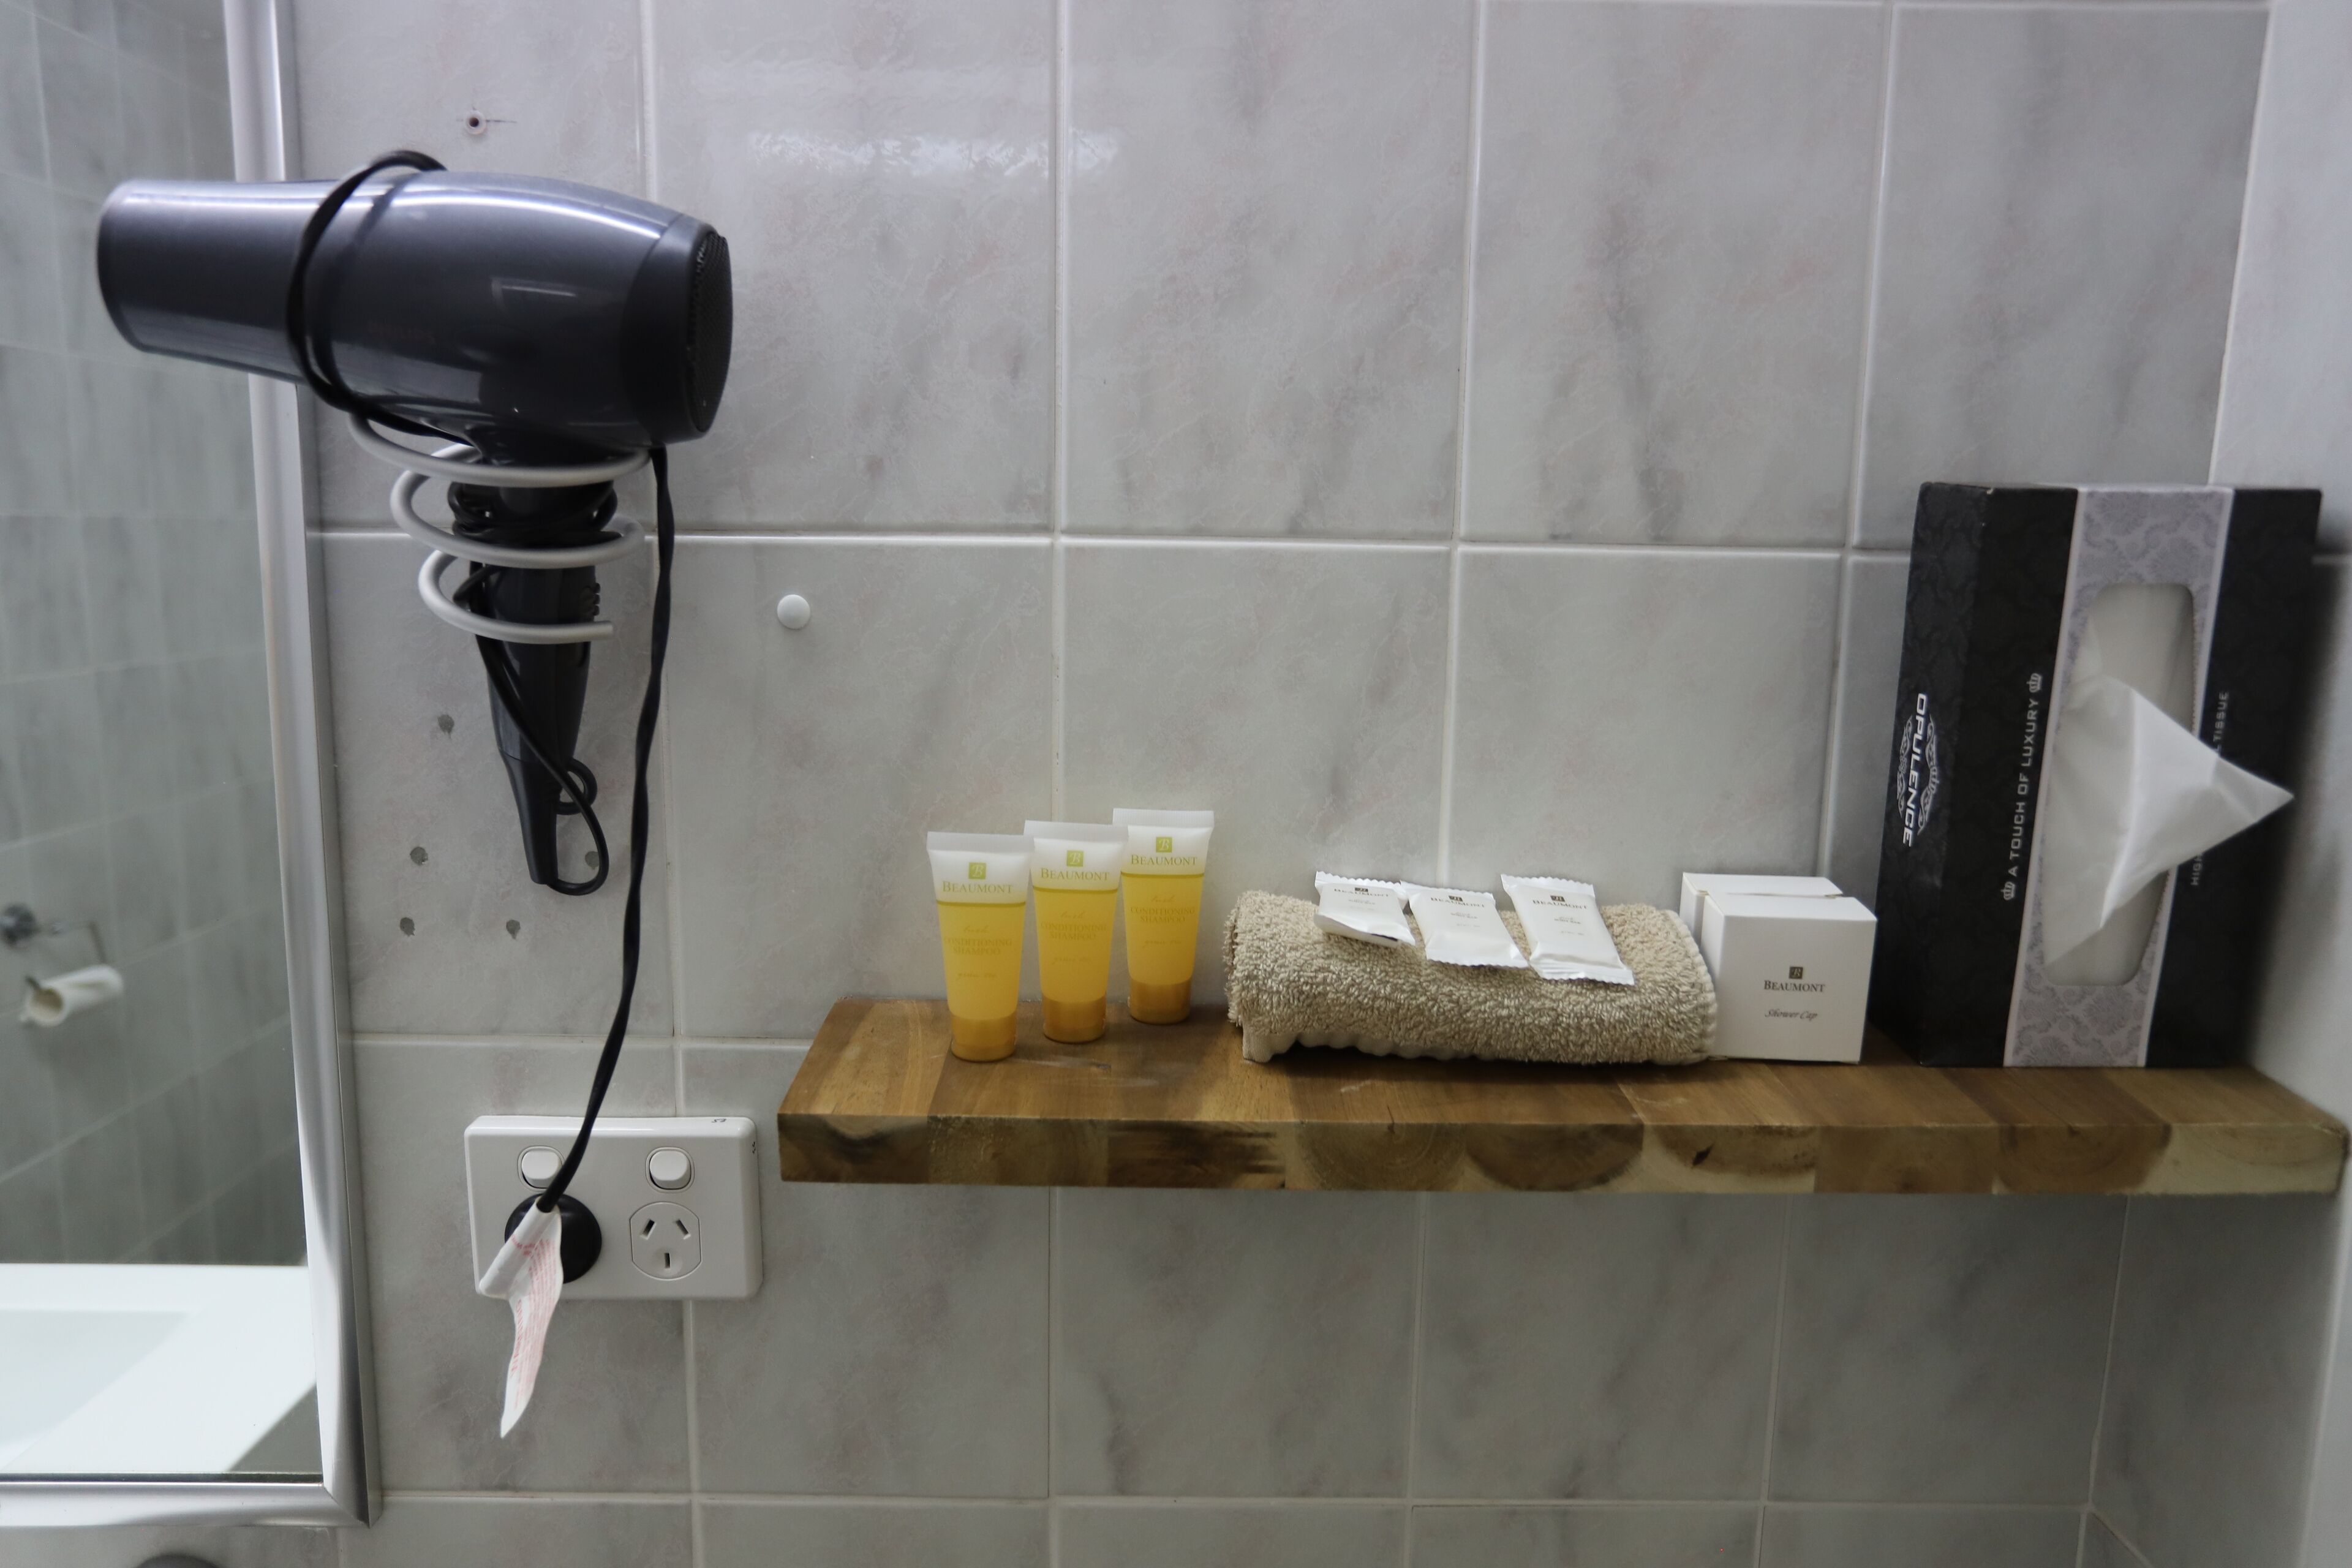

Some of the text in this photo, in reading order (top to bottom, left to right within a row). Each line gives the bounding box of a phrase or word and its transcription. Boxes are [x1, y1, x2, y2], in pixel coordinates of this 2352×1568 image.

[2213, 692, 2230, 742] TISSUE
[1903, 693, 1927, 847] OPULENCE
[2008, 700, 2040, 876] A TOUCH OF LUXURY
[1131, 854, 1198, 866] BEAUMONT
[1041, 868, 1110, 881] BEAUMONT
[942, 881, 1014, 894] BEAUMONT
[1334, 888, 1389, 897] BEAUMONT
[1431, 897, 1485, 908] BEAUMONT
[1532, 899, 1587, 910] BEAUMONT
[1131, 907, 1195, 915] CONDITIONING
[1039, 922, 1107, 932] CONDITIONING
[944, 937, 1012, 946] CONDITIONING
[1049, 932, 1096, 940] SHAMPOO
[952, 946, 1001, 956] SHAMPOO
[1764, 979, 1825, 993] BEAUMONT
[1765, 1008, 1818, 1022] Shower Cap
